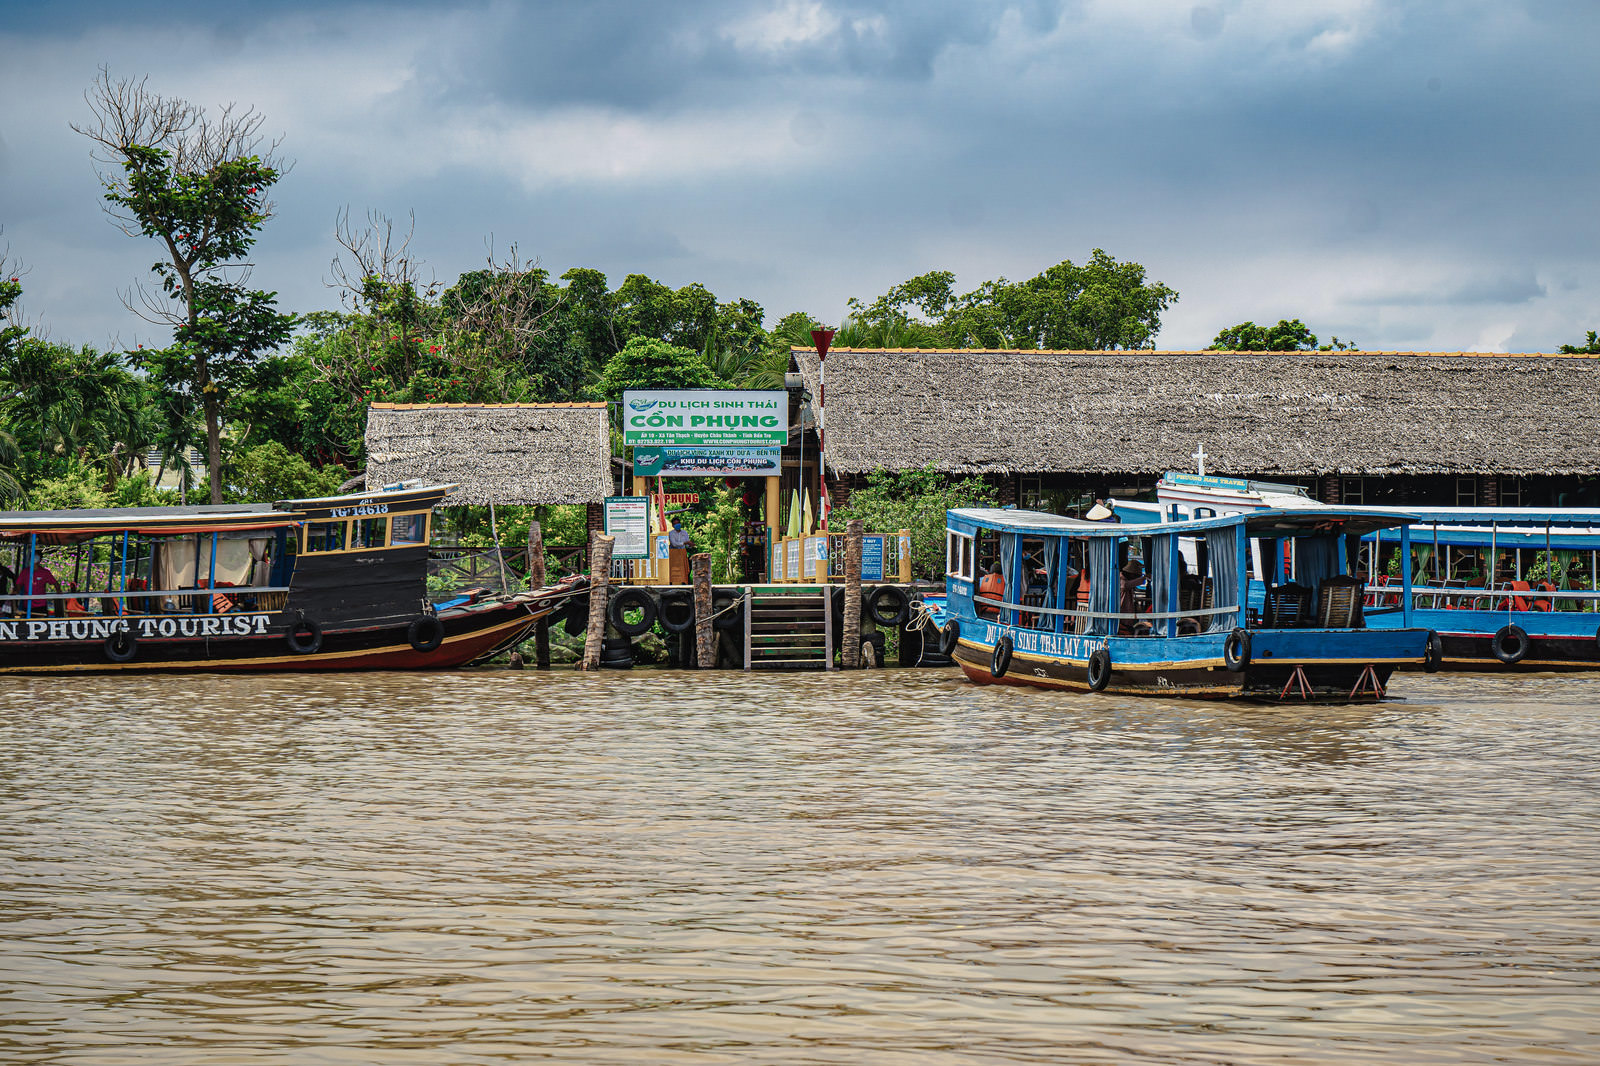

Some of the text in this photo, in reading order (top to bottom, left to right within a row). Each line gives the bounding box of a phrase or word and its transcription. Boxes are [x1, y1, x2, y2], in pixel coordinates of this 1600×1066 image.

[658, 401, 677, 409] DU
[684, 401, 710, 410] LỊCH
[713, 401, 744, 409] SINH
[630, 410, 779, 430] CỒN PHỤNG
[709, 458, 725, 466] LỊCH
[26, 619, 130, 640] PHUNG
[138, 615, 271, 637] TOURIST
[1017, 631, 1038, 652] SINH
